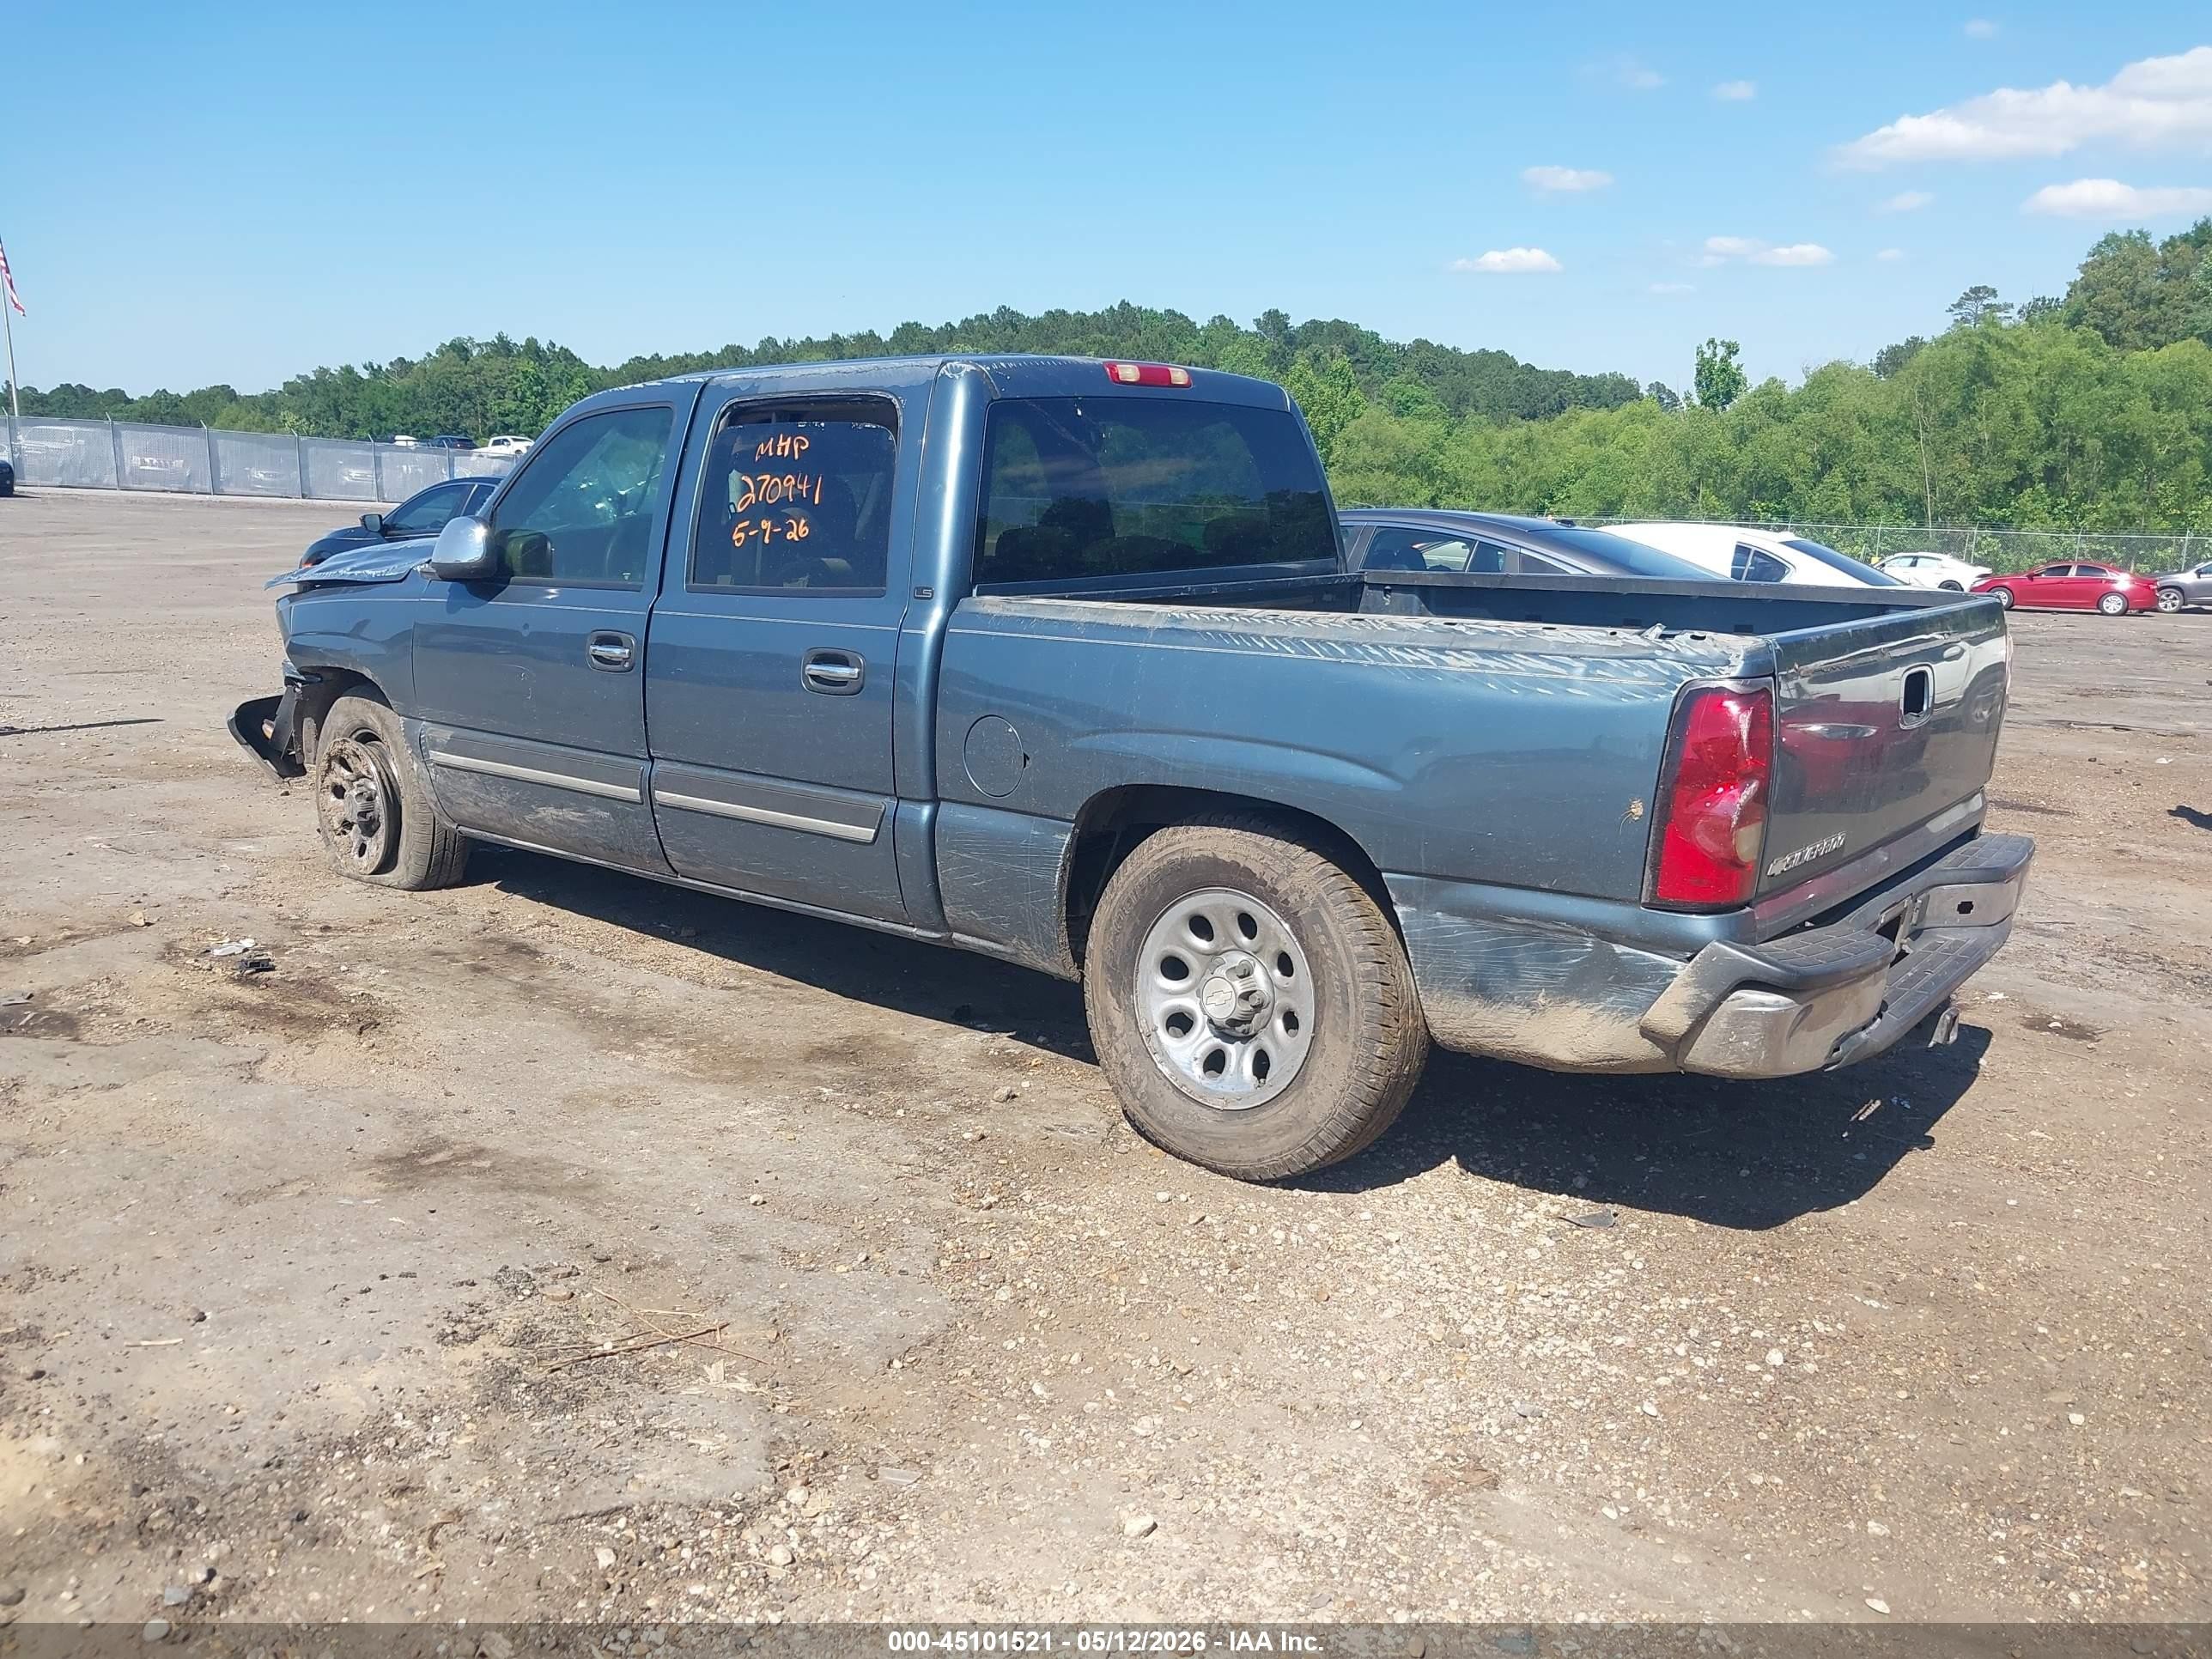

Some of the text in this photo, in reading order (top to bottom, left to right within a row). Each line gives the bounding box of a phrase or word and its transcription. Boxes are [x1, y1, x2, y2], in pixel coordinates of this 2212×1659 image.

[754, 433, 811, 462] MHP
[736, 472, 823, 513] 270941
[732, 518, 811, 548] 5-9-26
[915, 587, 933, 599] LS
